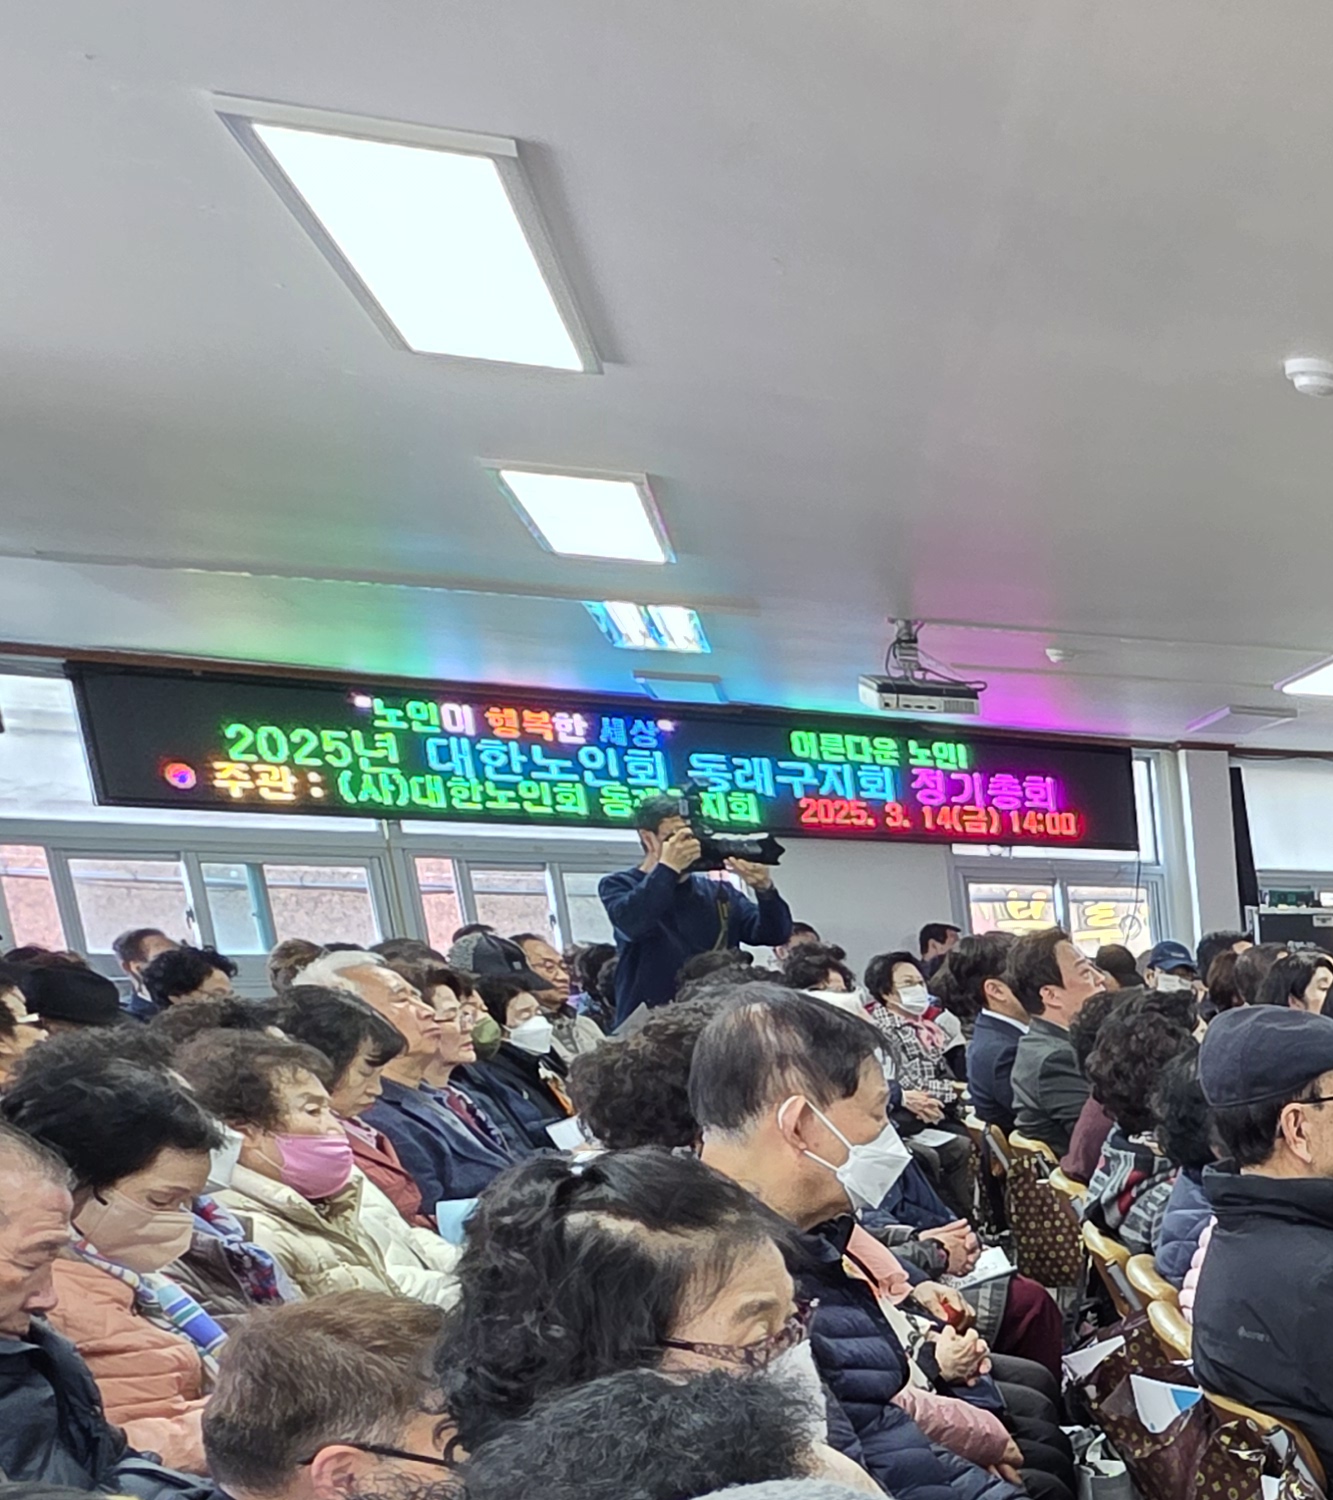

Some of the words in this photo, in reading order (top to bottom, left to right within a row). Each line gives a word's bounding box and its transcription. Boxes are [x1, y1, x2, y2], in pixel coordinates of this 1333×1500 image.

[485, 707, 588, 744] 행복한
[789, 730, 900, 767] 어른다운
[222, 723, 402, 773] 2025년
[424, 733, 668, 792] 대한노인회
[686, 751, 897, 803] 동래구지회
[910, 766, 1059, 812] 정기총회
[337, 768, 590, 817] (사)대한노인회
[799, 798, 876, 829] 2025.
[885, 802, 911, 830] 3.
[922, 804, 1001, 835] 14(금)
[1009, 810, 1080, 838] 14:00
